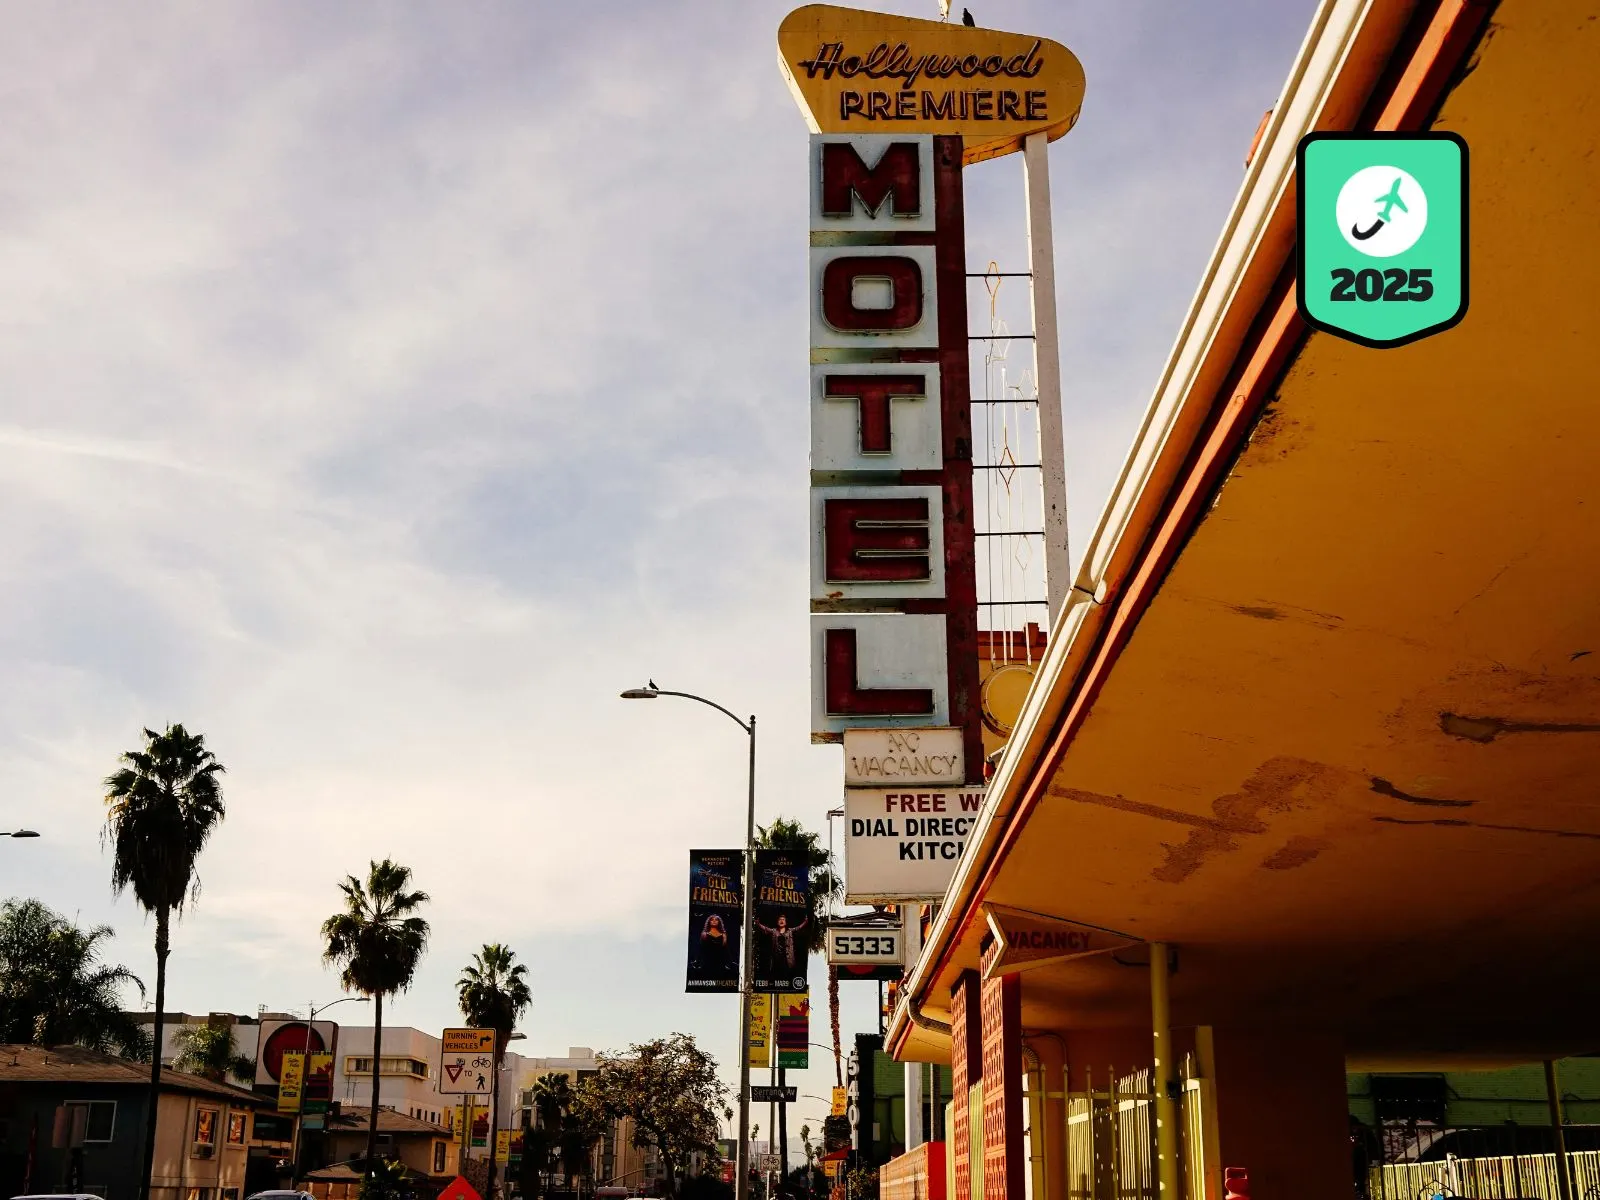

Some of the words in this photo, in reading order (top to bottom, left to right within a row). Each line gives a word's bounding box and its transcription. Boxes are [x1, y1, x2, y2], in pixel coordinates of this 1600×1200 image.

[798, 40, 1043, 89] Hollywood
[840, 89, 1048, 121] PREMIERE
[822, 142, 935, 718] MOTEL
[852, 756, 958, 777] VACANCY
[886, 794, 946, 812] FREE
[852, 819, 898, 837] DIAL
[708, 876, 727, 890] OLD
[774, 876, 794, 890] OLD
[693, 887, 738, 904] FRIENDS
[759, 886, 806, 904] FRIENDS
[835, 937, 894, 954] 5333
[1007, 931, 1091, 949] VACANCY
[753, 1088, 782, 1096] Serrano
